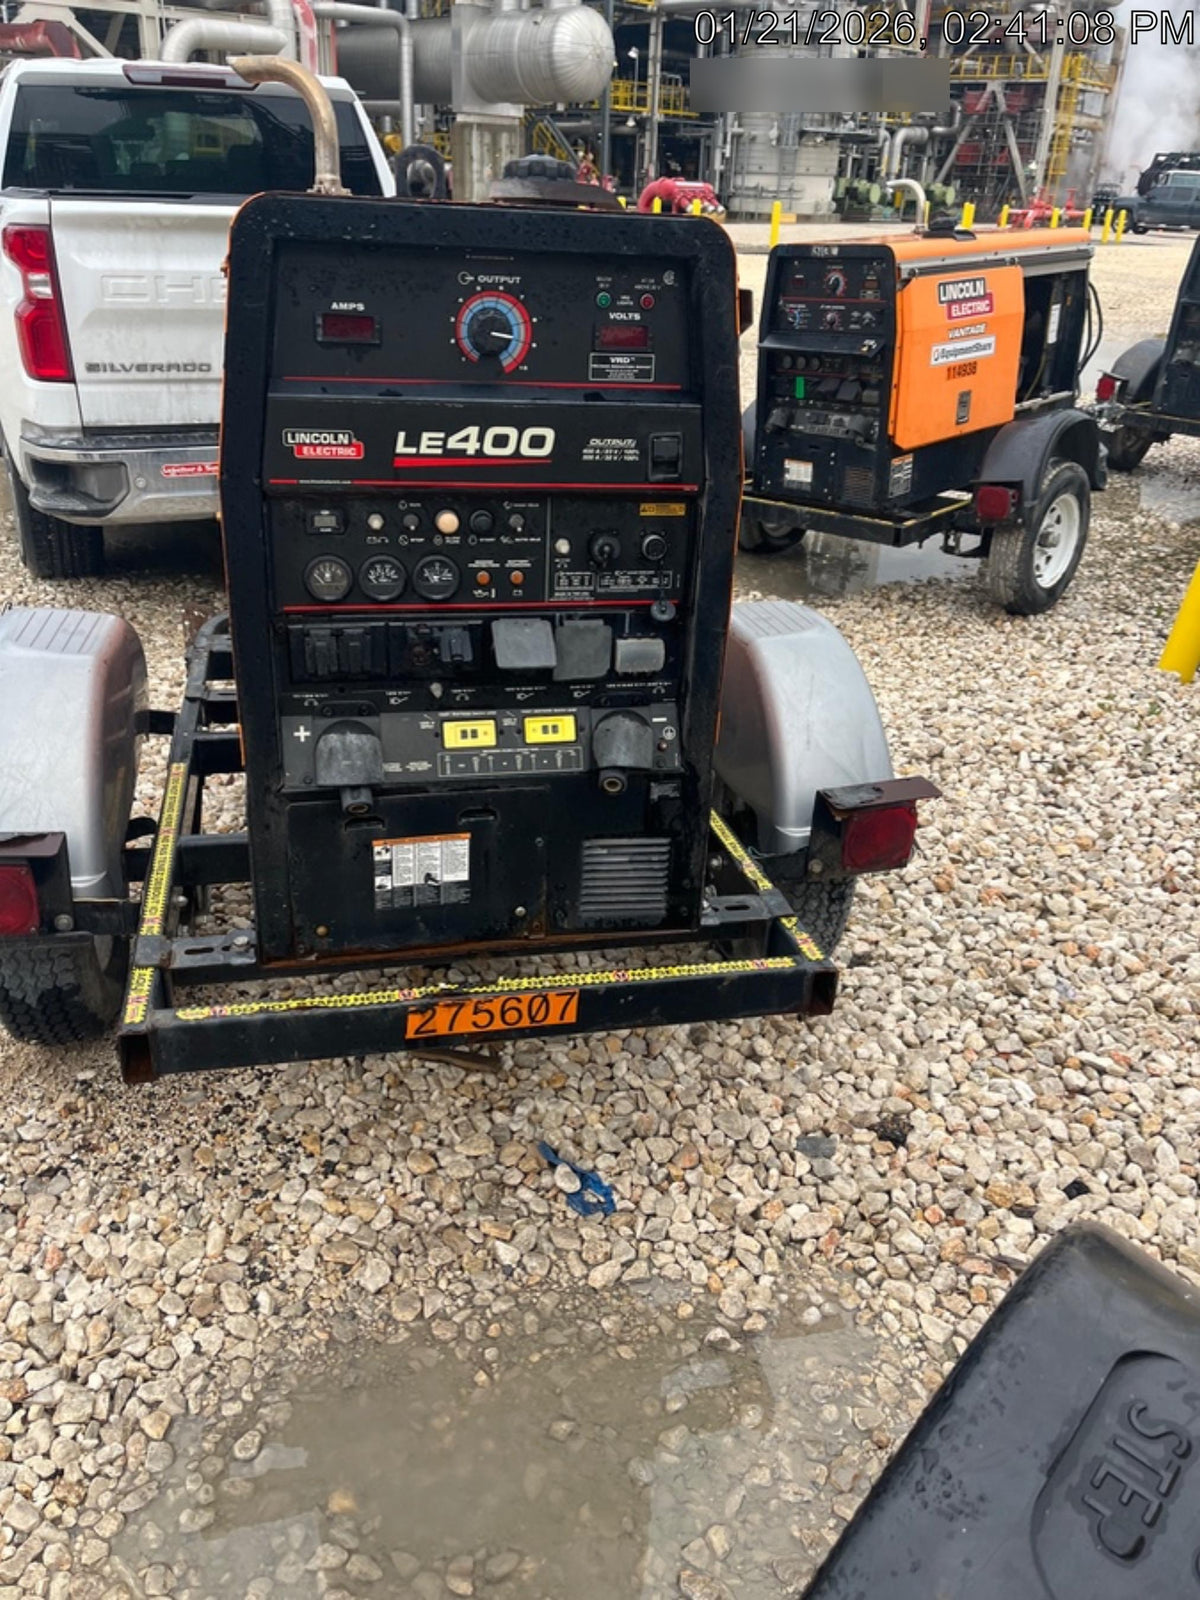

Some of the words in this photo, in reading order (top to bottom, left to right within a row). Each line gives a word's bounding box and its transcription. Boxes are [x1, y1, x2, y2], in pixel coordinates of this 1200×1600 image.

[478, 275, 521, 283] OUTPUT
[939, 280, 984, 302] LINCOLN
[330, 302, 365, 311] AMPS
[951, 300, 991, 317] ELECTRIC
[609, 312, 642, 321] VOLTS
[948, 323, 987, 339] VANTAGE
[85, 362, 212, 373] SILVERADO
[287, 431, 349, 445] LINCOLN
[395, 425, 555, 457] LE400
[302, 445, 357, 456] ELECTRIC
[408, 991, 578, 1036] 275607
